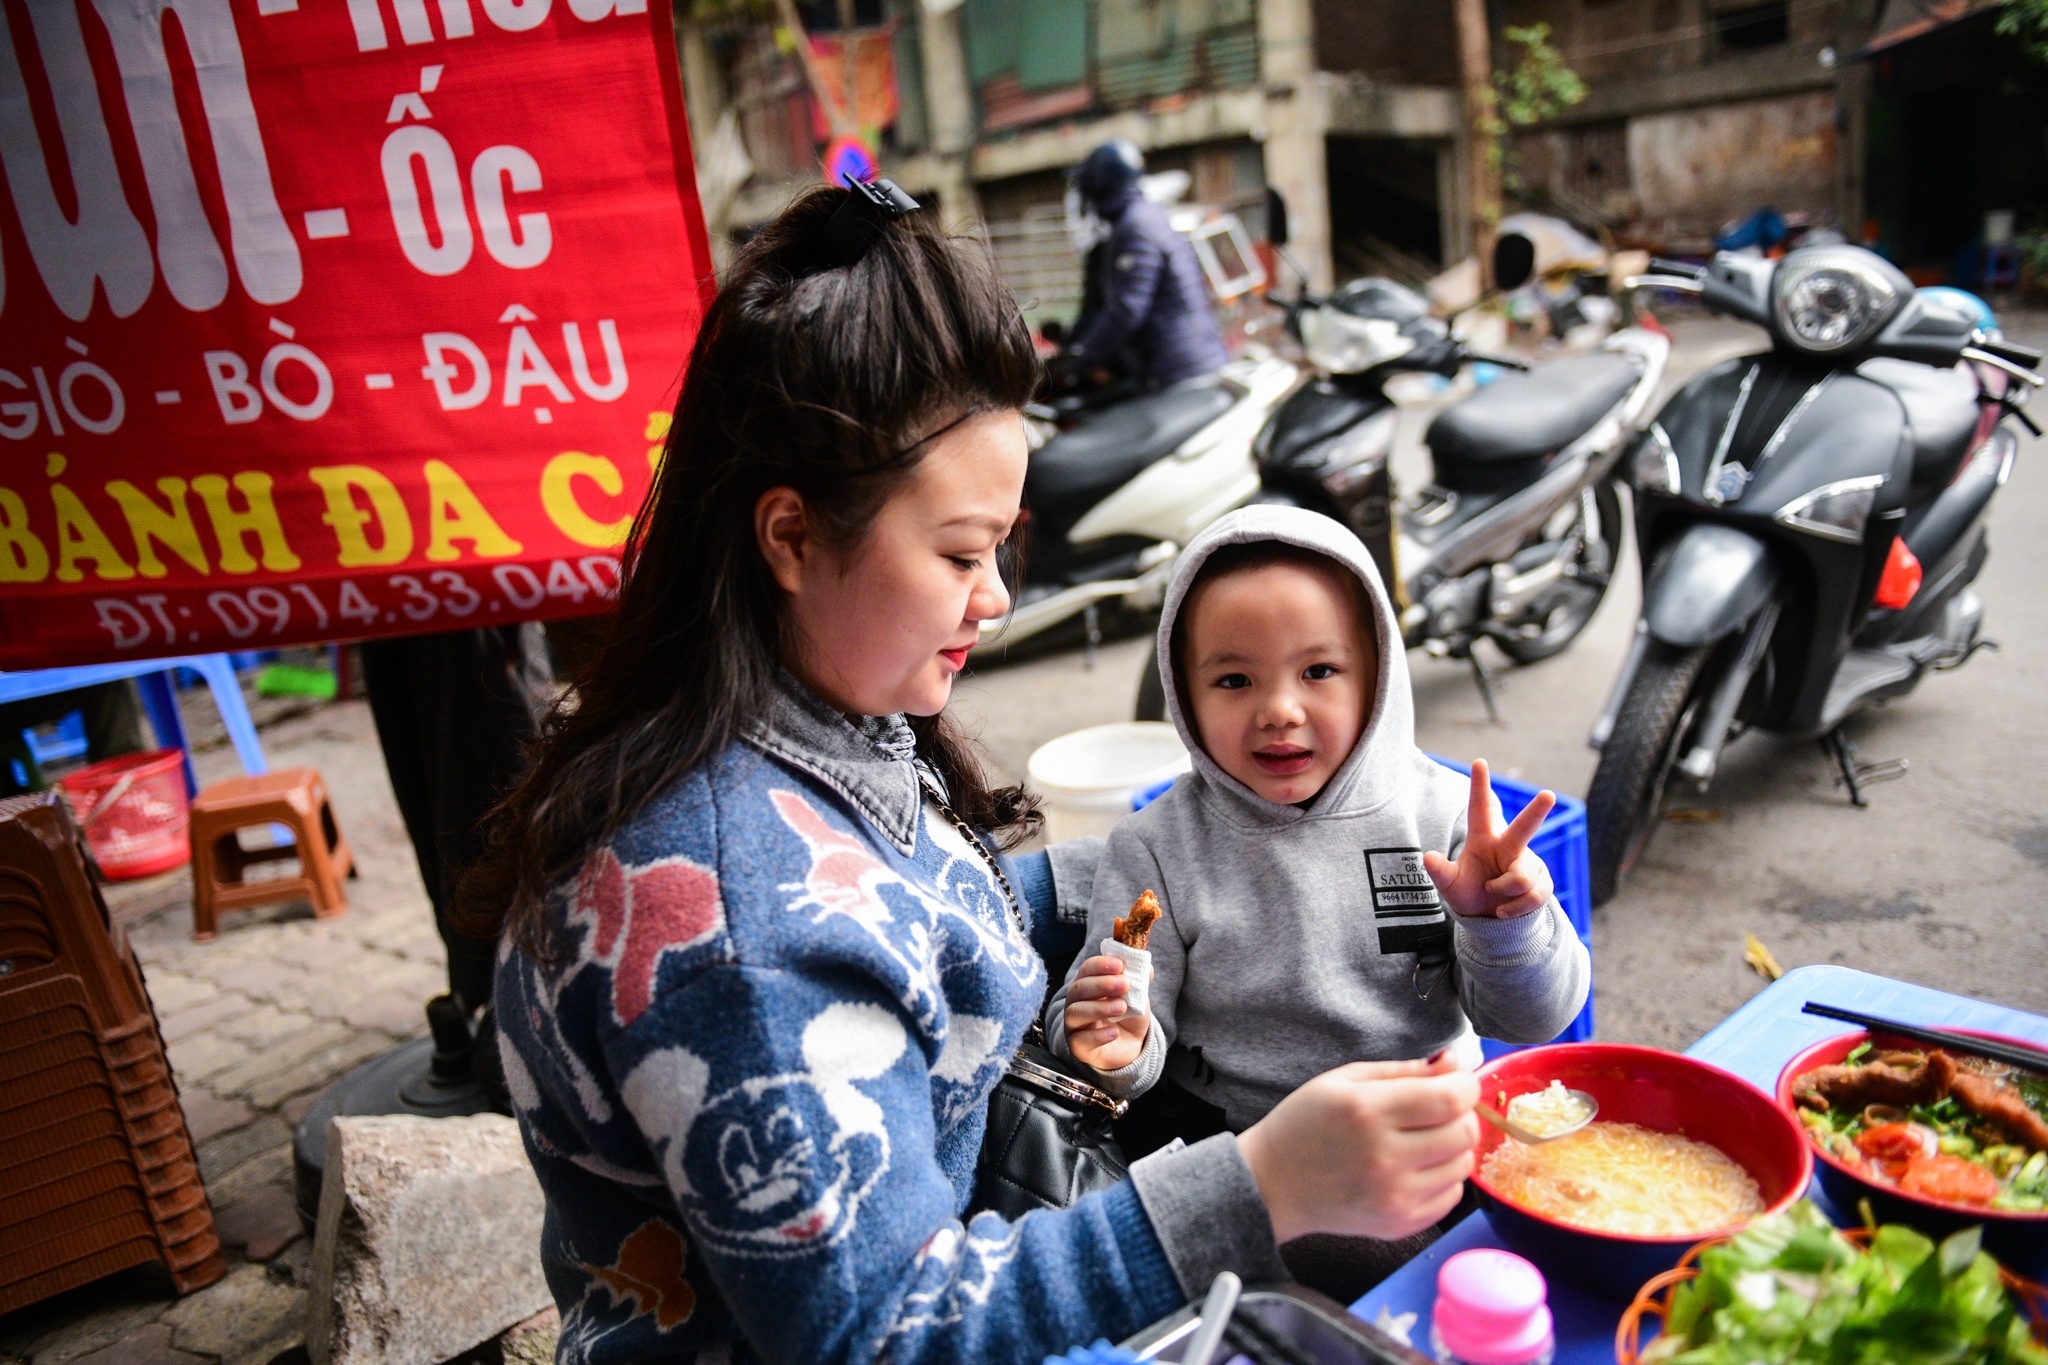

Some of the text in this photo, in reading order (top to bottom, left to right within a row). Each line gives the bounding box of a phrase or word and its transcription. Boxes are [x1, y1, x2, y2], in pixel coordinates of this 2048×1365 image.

[0, 336, 126, 441] GIÒ
[203, 317, 335, 425] BÒ
[421, 304, 630, 424] ĐẬU
[0, 411, 674, 583] BÁNH ĐA C
[93, 592, 200, 649] ĐT:
[1382, 893, 1400, 901] 9664
